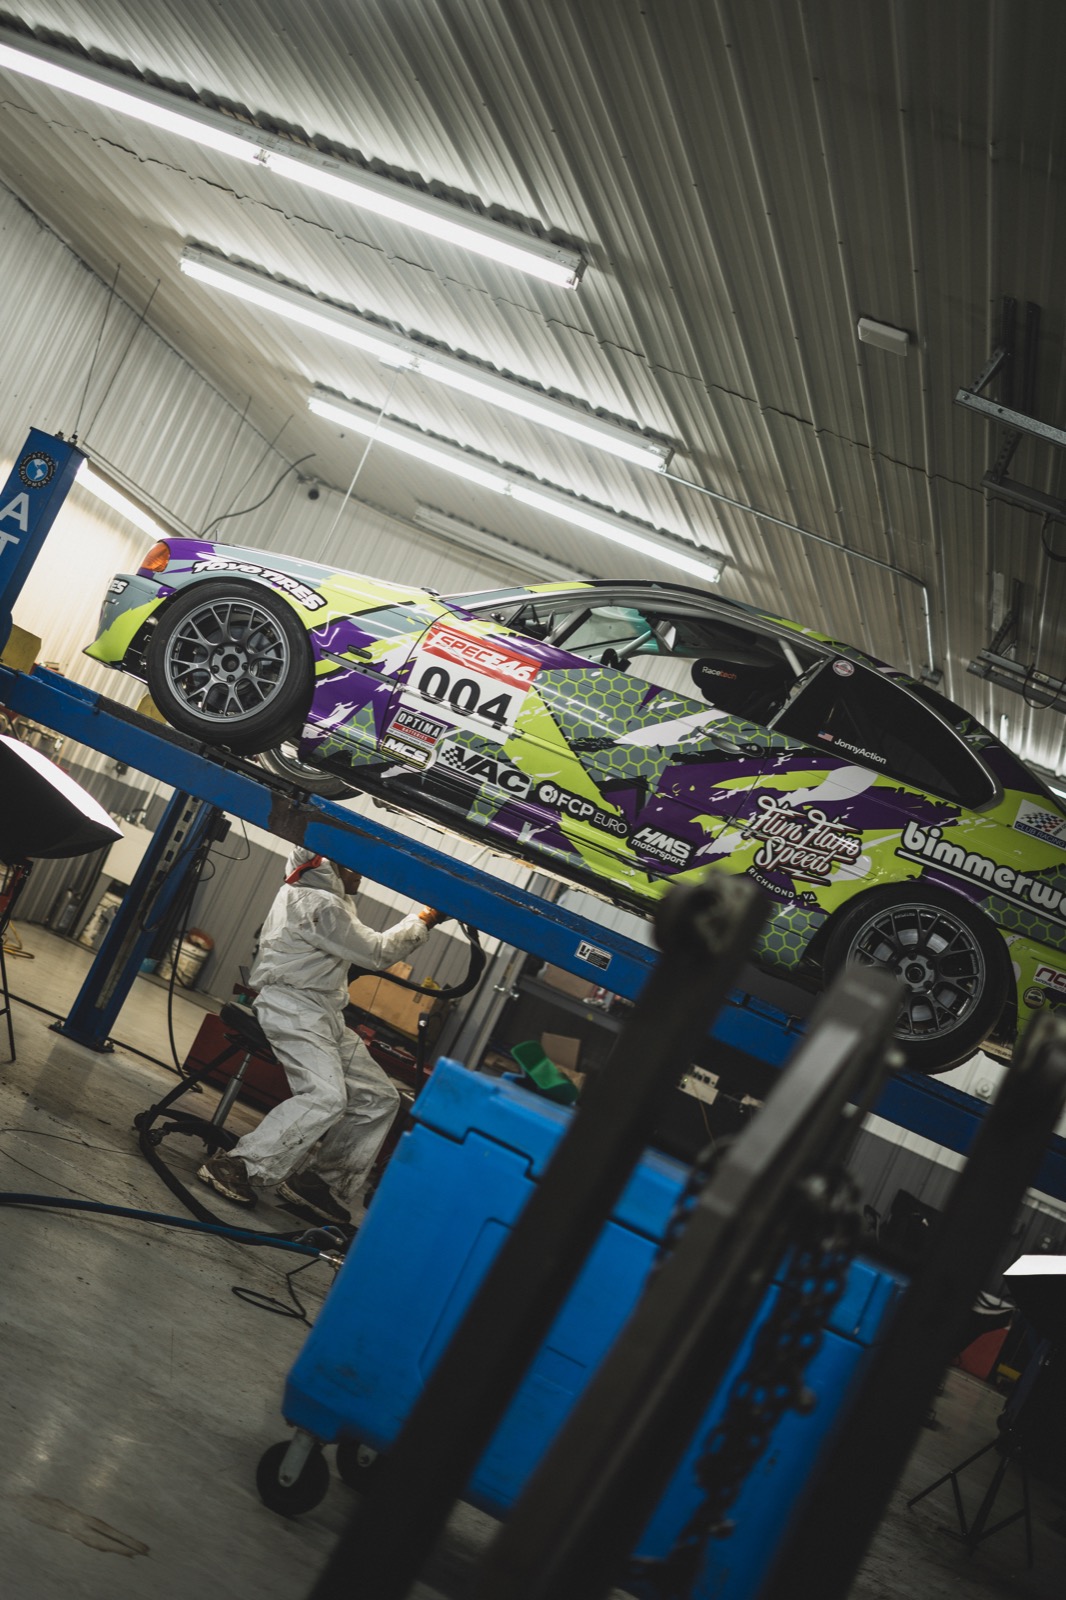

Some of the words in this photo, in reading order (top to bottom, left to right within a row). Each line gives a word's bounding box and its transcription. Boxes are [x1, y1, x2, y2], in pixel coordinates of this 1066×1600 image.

[20, 464, 52, 487] EQUIPMENT
[193, 561, 261, 574] TOYO
[261, 567, 325, 610] TIRES
[702, 666, 737, 680] Racetech
[418, 666, 512, 729] 004
[398, 713, 440, 738] OPTIMA
[384, 738, 429, 763] MCS
[834, 738, 887, 765] JonnyAction
[453, 745, 532, 793] VAC
[556, 790, 594, 817] FCP
[593, 813, 629, 835] EURO
[744, 795, 806, 842] Flim
[635, 827, 693, 860] HMS
[1015, 821, 1037, 836] CLUB
[1036, 829, 1066, 848] RACING
[631, 838, 687, 867] motorsport
[755, 836, 837, 873] Speed
[903, 820, 1066, 917] bimmerw
[748, 867, 795, 898] RICHMOND
[803, 893, 816, 901] VA
